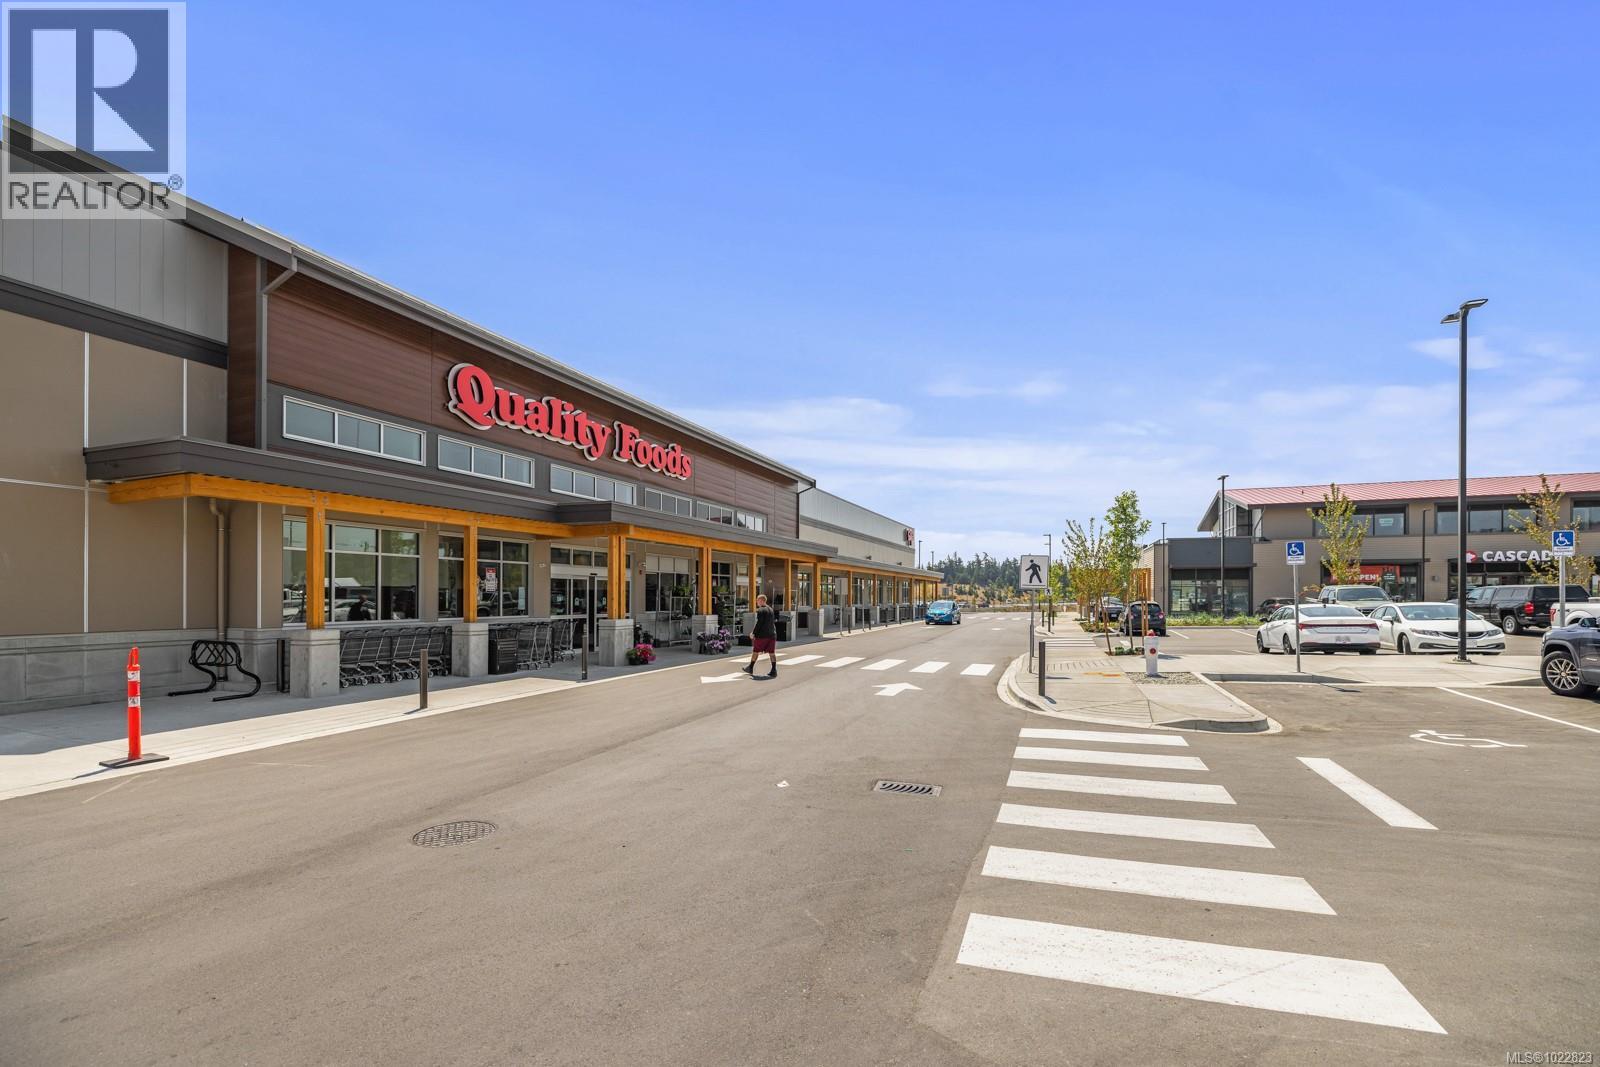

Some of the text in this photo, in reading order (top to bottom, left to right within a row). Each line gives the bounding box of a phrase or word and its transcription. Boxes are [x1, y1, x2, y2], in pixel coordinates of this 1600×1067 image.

[448, 363, 692, 480] Quality Foods
[1482, 550, 1571, 562] CASCAD
